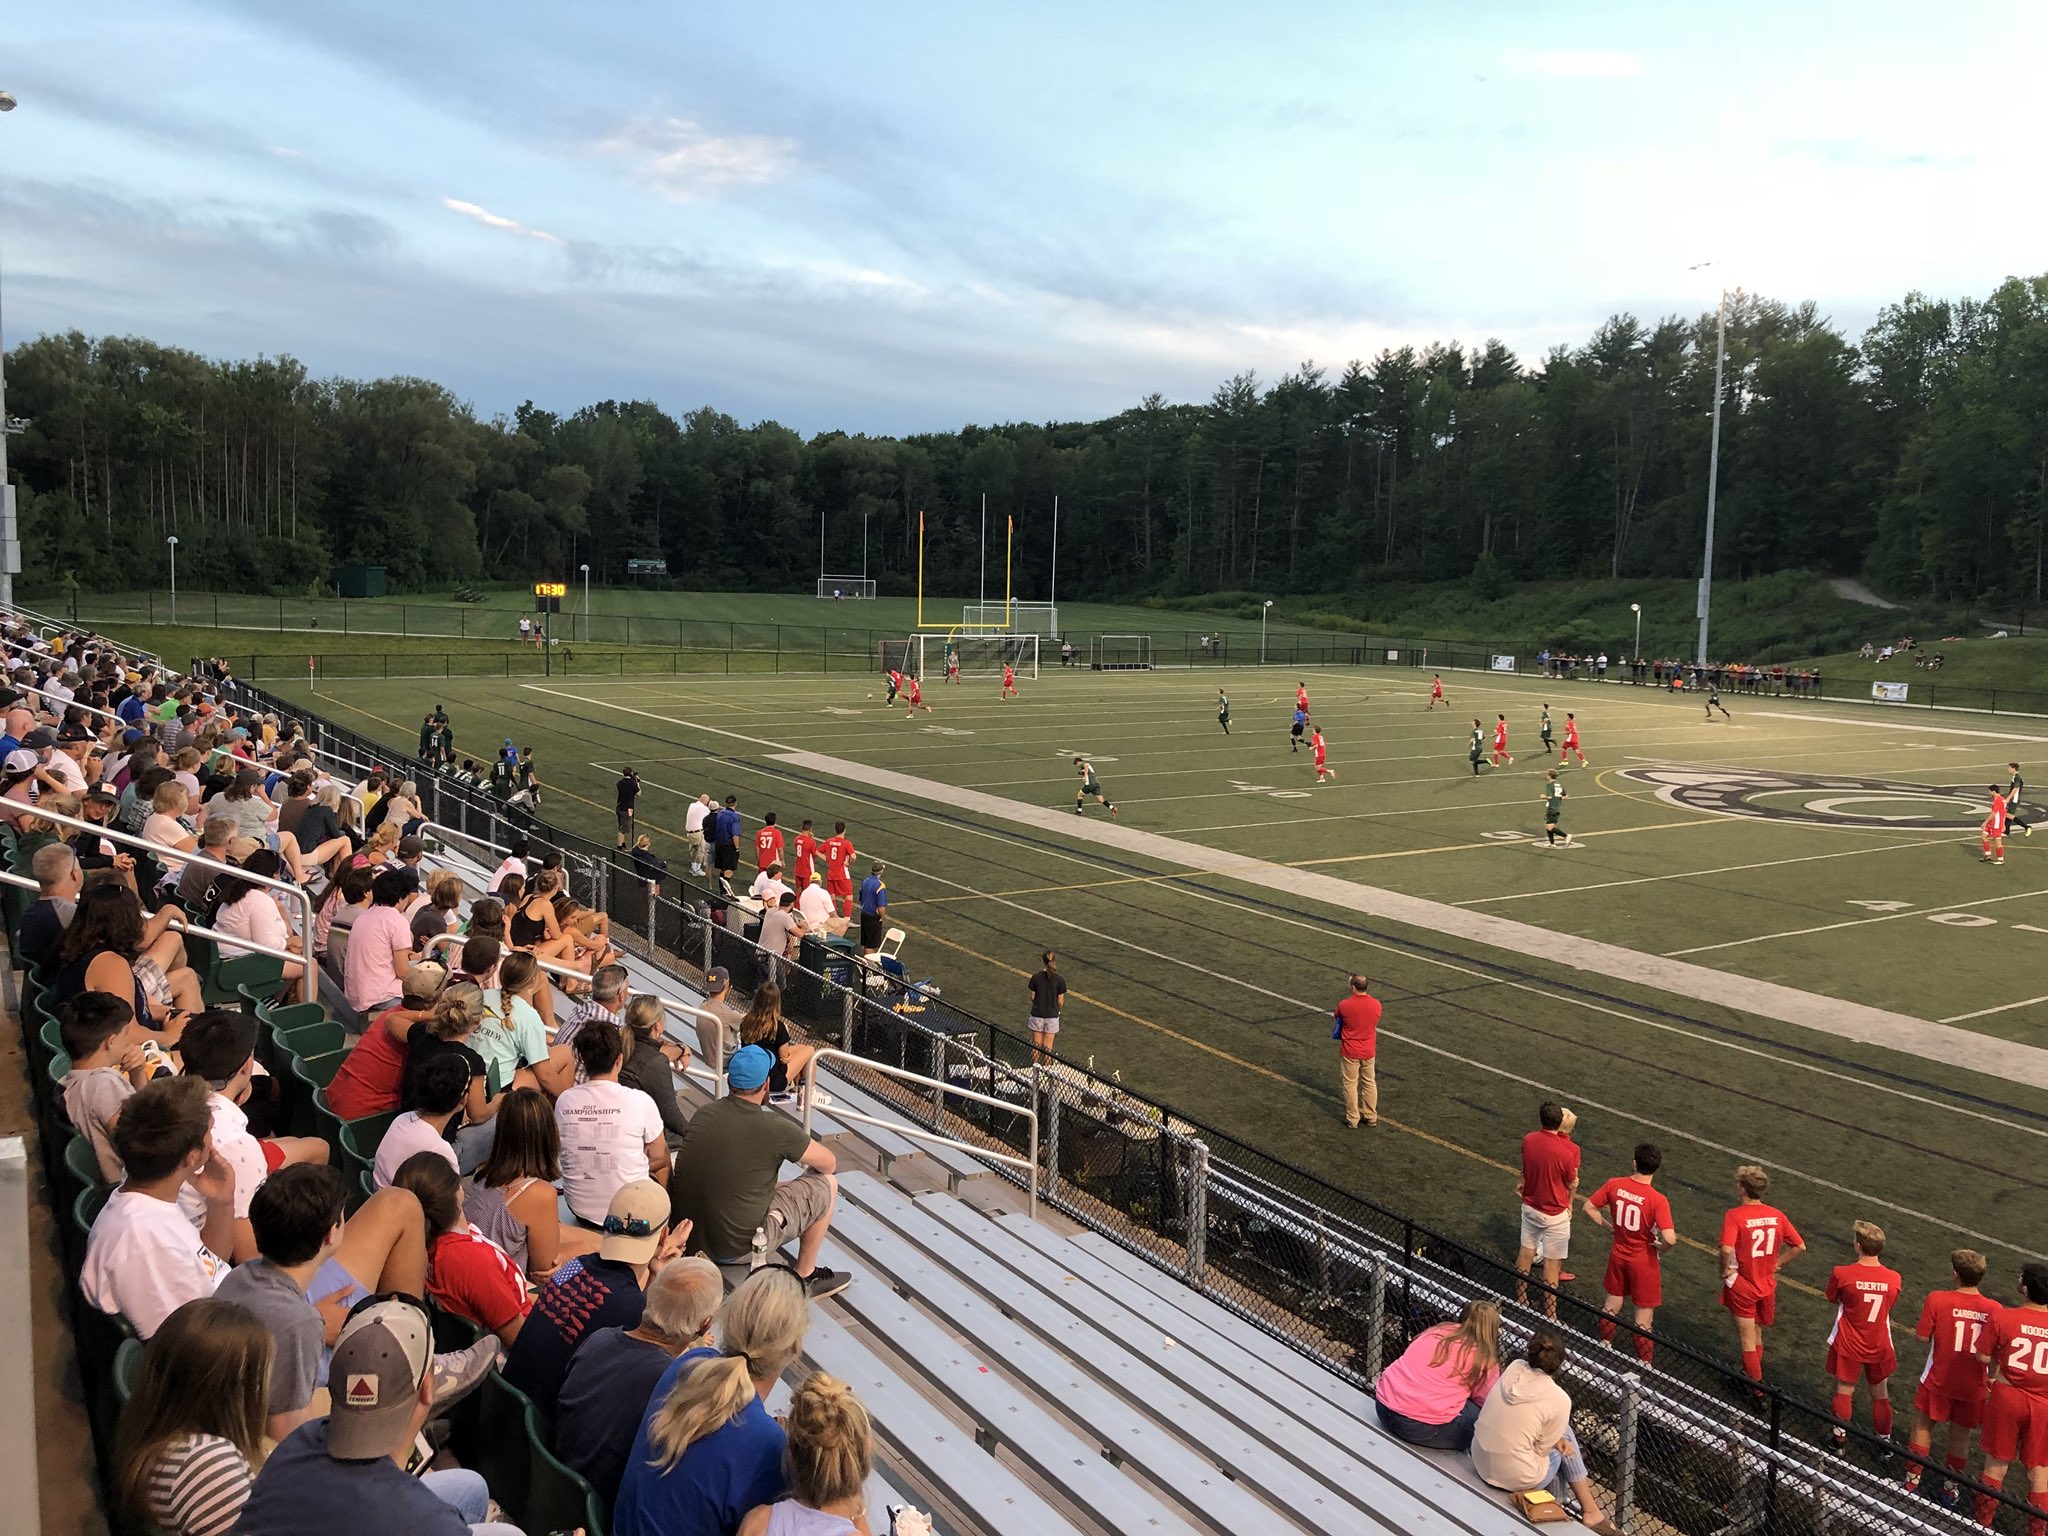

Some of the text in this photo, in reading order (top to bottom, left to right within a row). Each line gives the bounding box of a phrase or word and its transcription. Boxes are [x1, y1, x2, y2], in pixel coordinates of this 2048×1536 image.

[535, 584, 566, 596] 17:30
[498, 765, 505, 776] 11
[760, 836, 773, 849] 37
[796, 844, 802, 858] 8
[831, 847, 838, 860] 6
[562, 1108, 621, 1116] CHAMPIONSHIPS
[1615, 1200, 1642, 1232] 10
[1751, 1228, 1776, 1258] 21
[1856, 1281, 1888, 1292] GUERTIN
[1863, 1293, 1884, 1323] 7
[1952, 1308, 1989, 1323] CARBONE
[2007, 1337, 2048, 1375] 20
